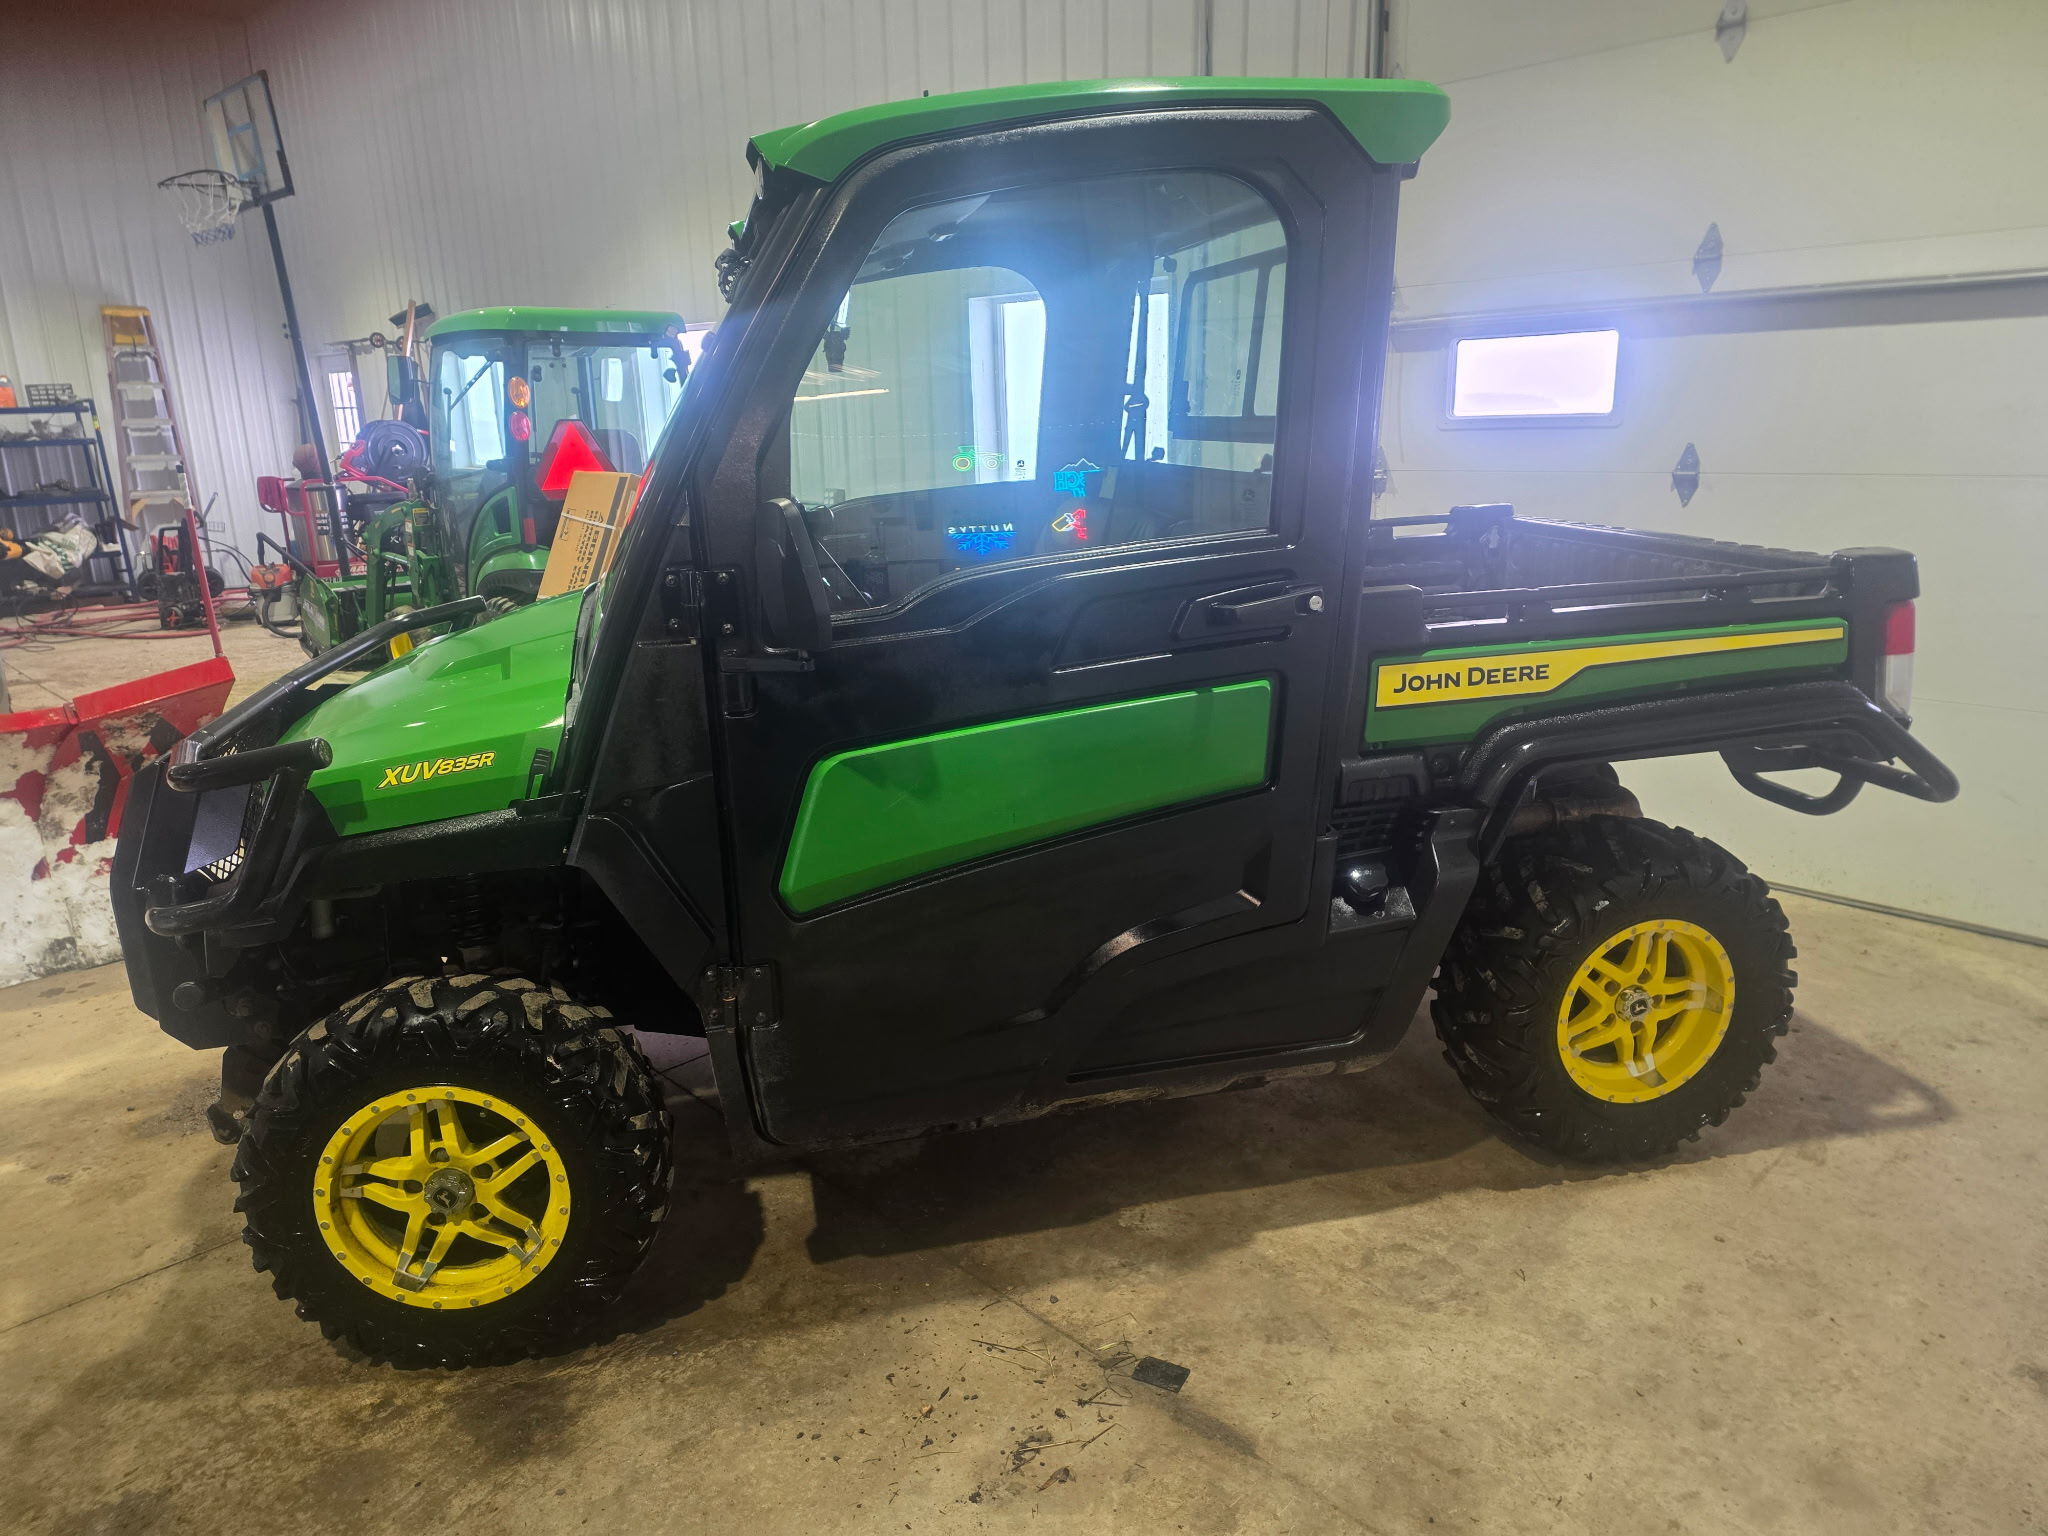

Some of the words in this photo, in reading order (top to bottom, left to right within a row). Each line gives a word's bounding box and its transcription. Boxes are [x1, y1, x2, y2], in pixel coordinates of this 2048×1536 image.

[1393, 671, 1461, 693] JOHN
[1467, 664, 1549, 687] DEERE
[374, 750, 497, 790] XUV835R
